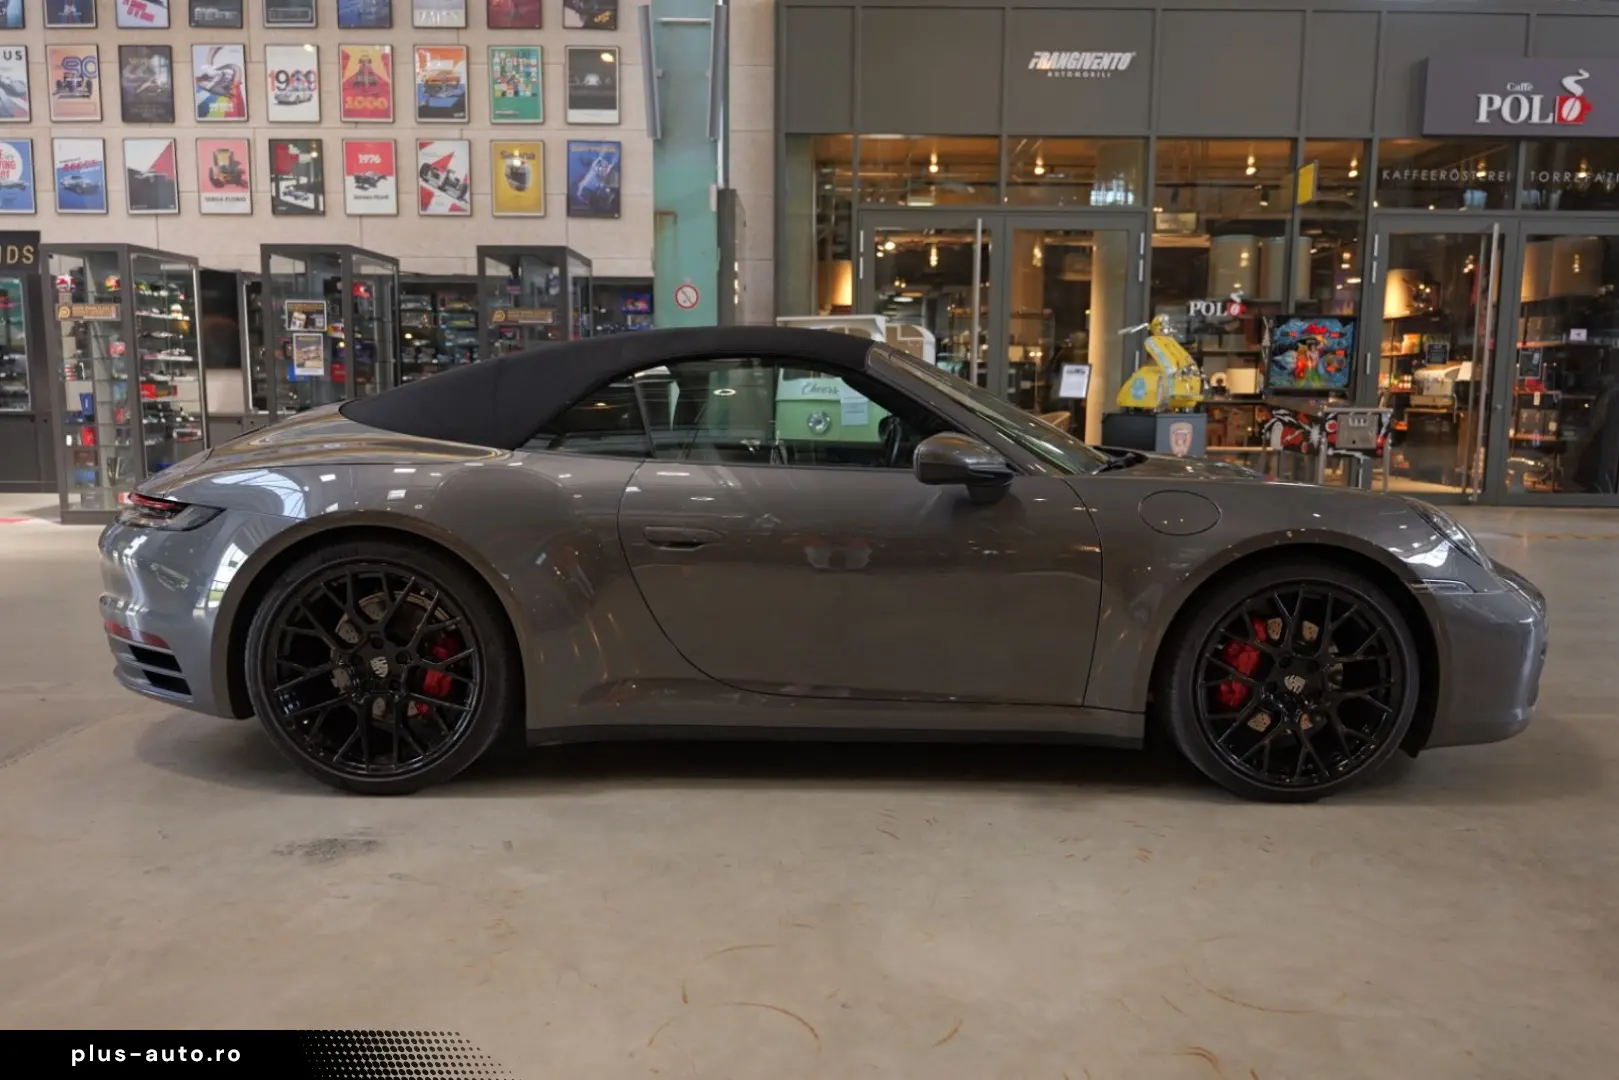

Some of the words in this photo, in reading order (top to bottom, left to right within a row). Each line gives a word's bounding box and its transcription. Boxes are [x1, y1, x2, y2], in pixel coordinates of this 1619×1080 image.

[1028, 51, 1132, 70] FRANGIVENTO
[1506, 82, 1534, 92] Caffè
[0, 245, 34, 264] DS
